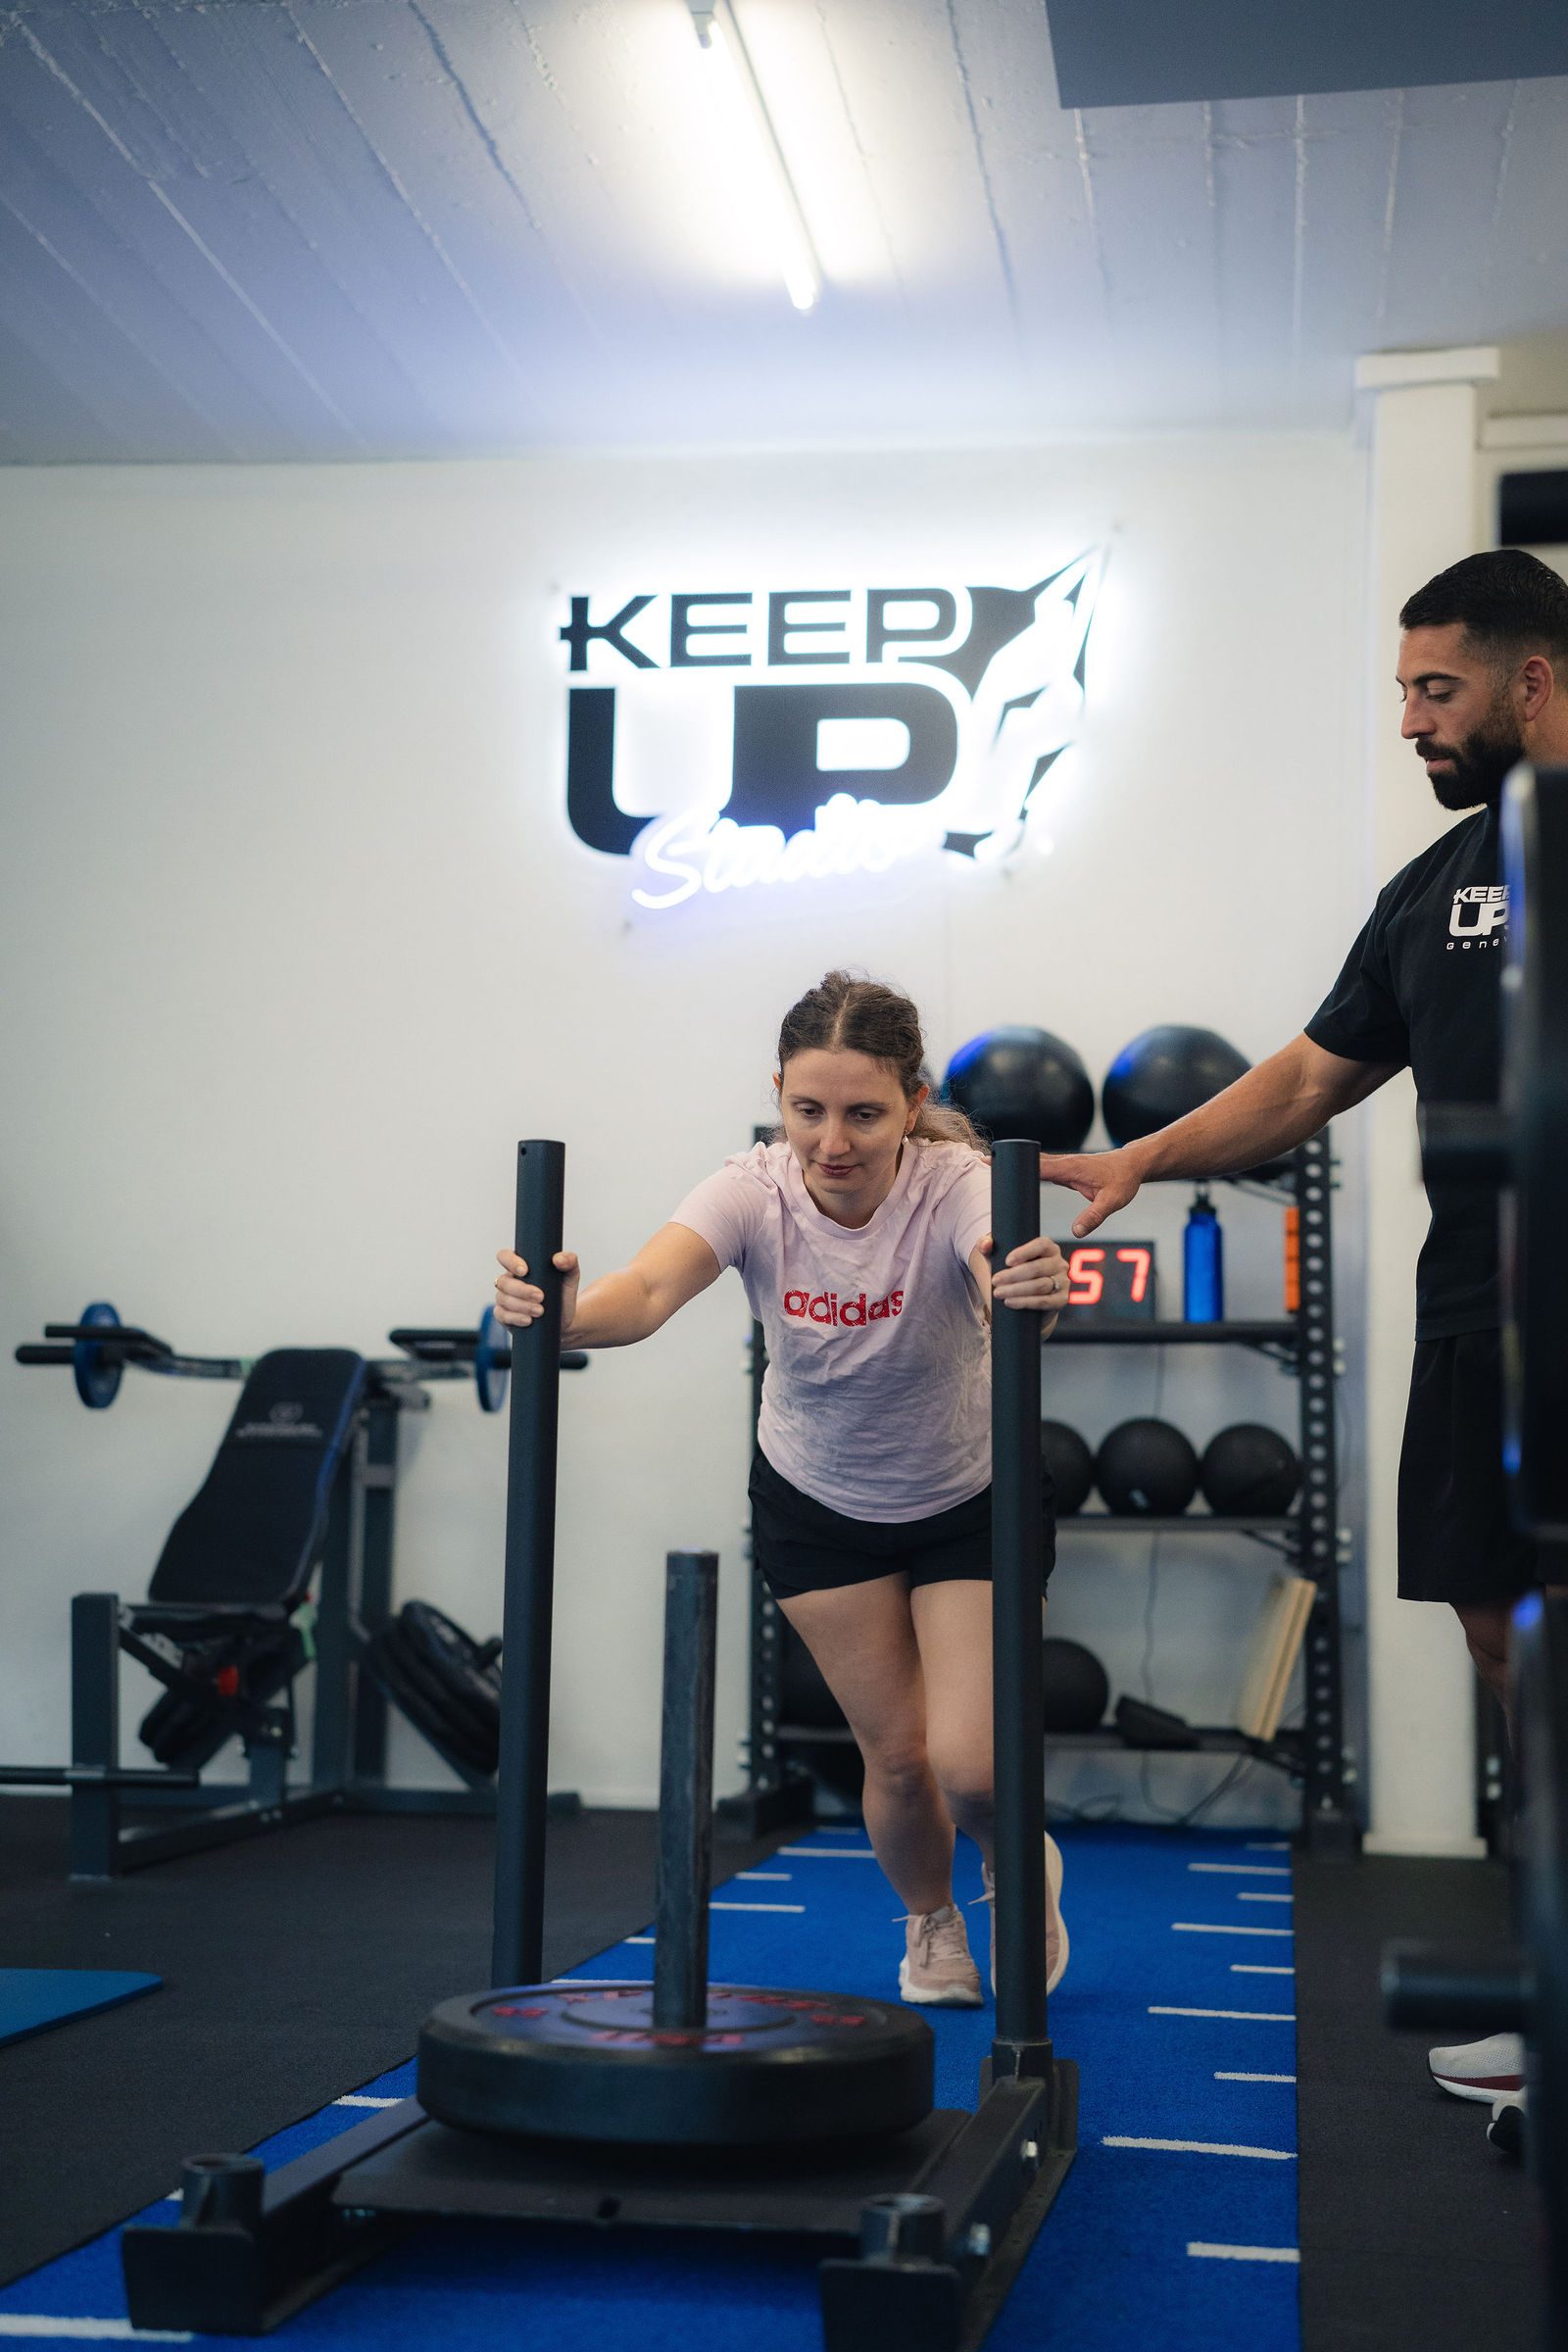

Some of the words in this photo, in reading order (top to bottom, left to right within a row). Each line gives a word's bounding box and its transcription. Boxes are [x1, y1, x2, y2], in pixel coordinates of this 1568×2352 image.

[560, 588, 957, 671] KEEP
[566, 682, 958, 856] UP
[1448, 900, 1510, 937] UP
[1068, 1248, 1151, 1304] 57
[784, 1290, 904, 1327] adidas
